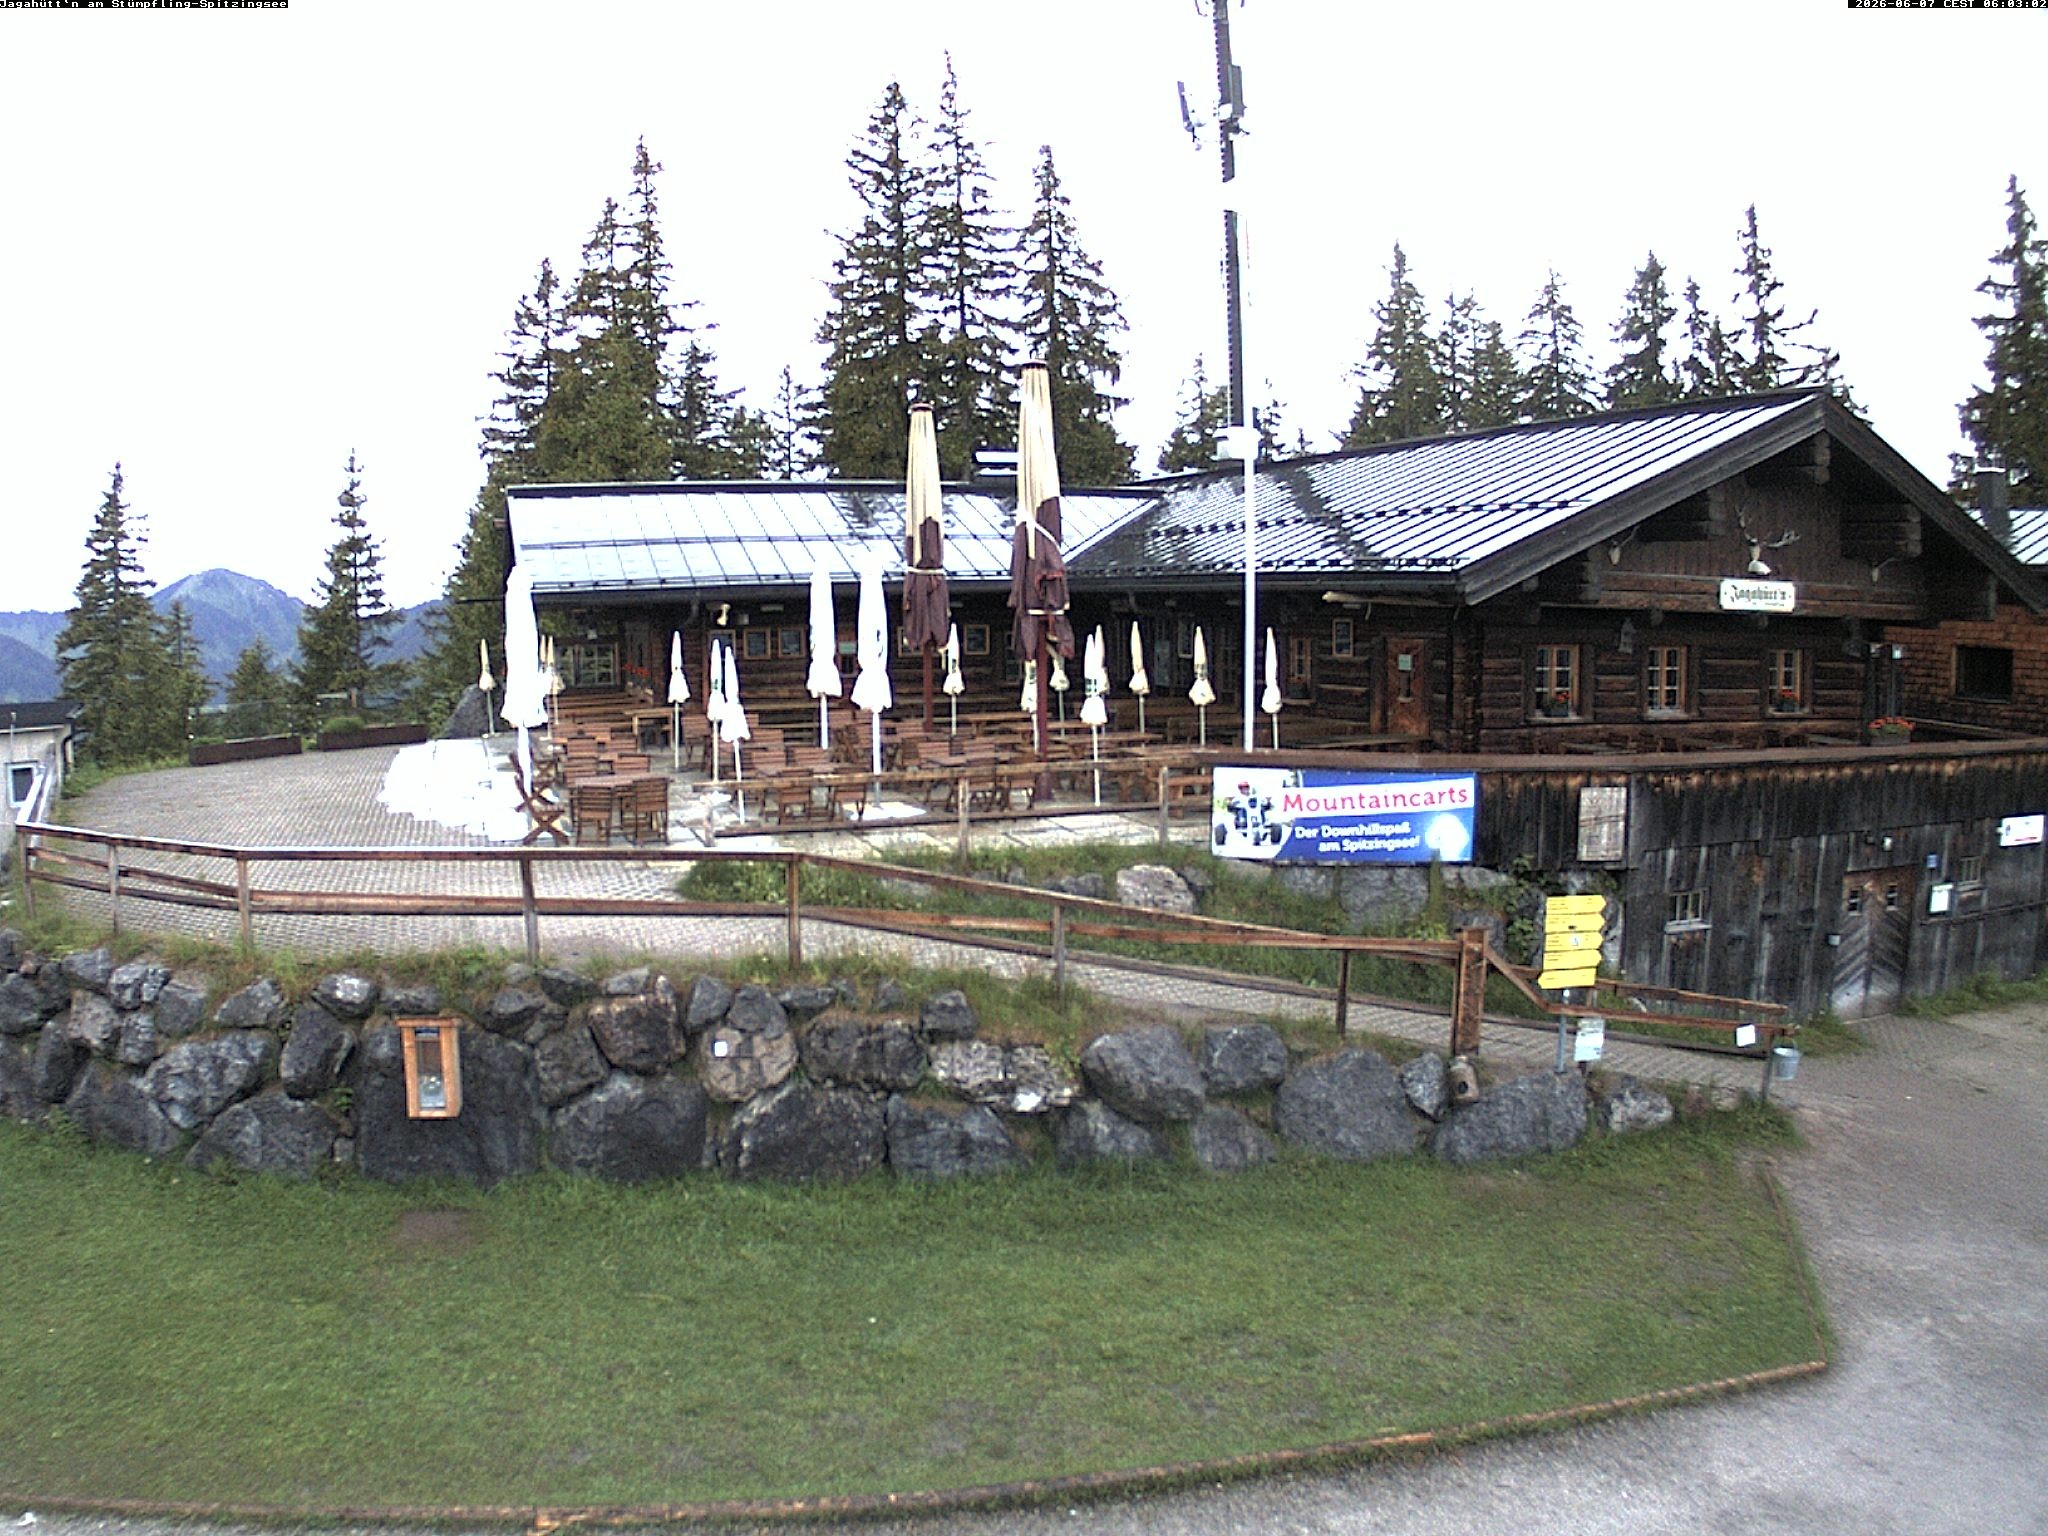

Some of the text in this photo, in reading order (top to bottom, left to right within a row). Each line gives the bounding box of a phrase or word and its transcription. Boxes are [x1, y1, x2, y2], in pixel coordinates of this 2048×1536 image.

[1283, 787, 1469, 812] Mountaincarts
[1294, 826, 1319, 838] Der
[1319, 842, 1341, 852] am
